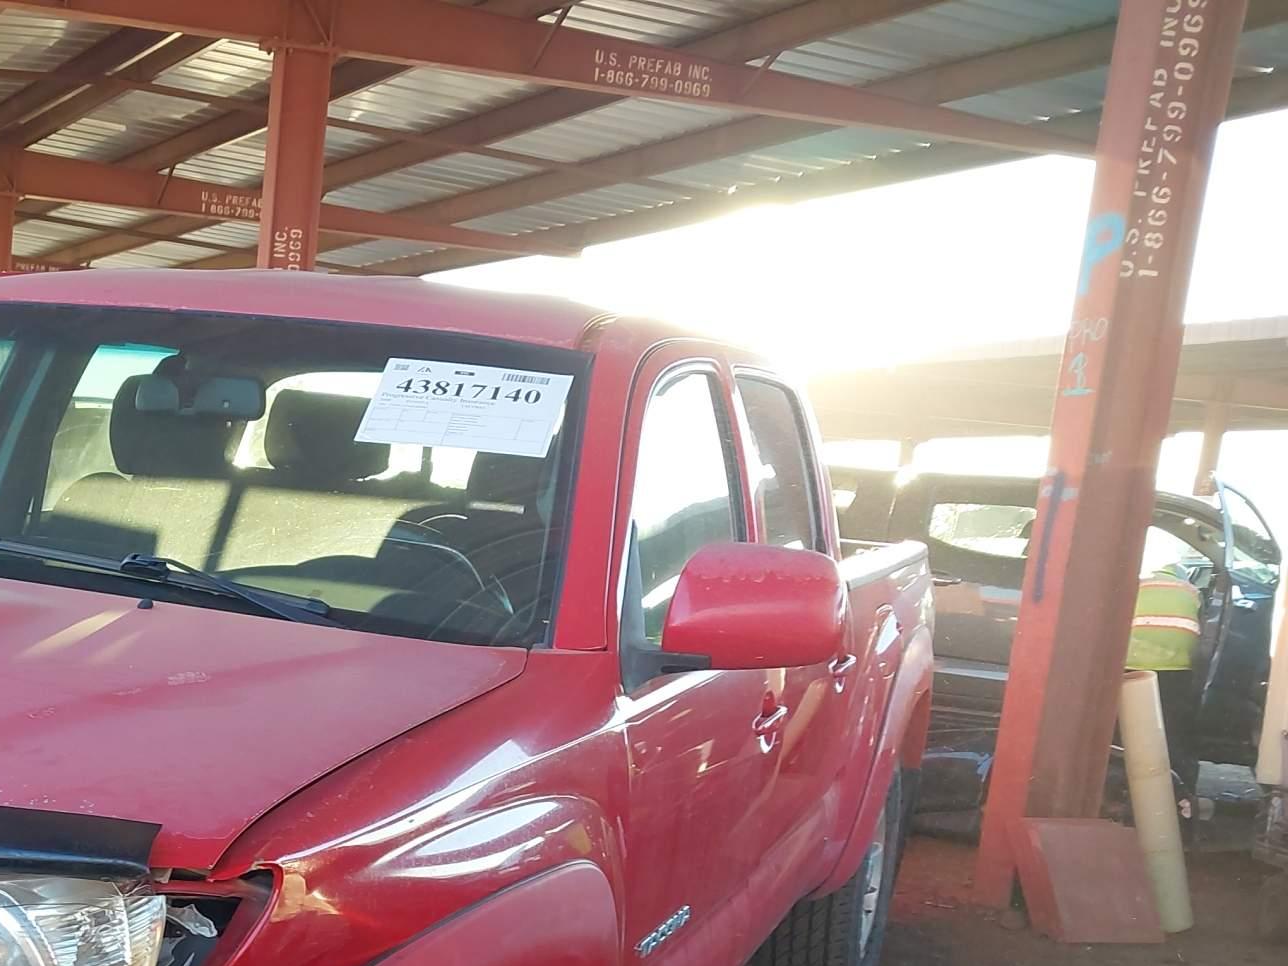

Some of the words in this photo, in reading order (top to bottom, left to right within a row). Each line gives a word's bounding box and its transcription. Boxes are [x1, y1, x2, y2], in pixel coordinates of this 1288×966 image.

[595, 49, 621, 68] U.S.
[628, 55, 682, 77] PREFAB
[688, 64, 712, 82] INC.
[594, 67, 711, 98] 1-866-799-0969
[273, 226, 288, 258] INC.
[395, 377, 542, 405] 43817140
